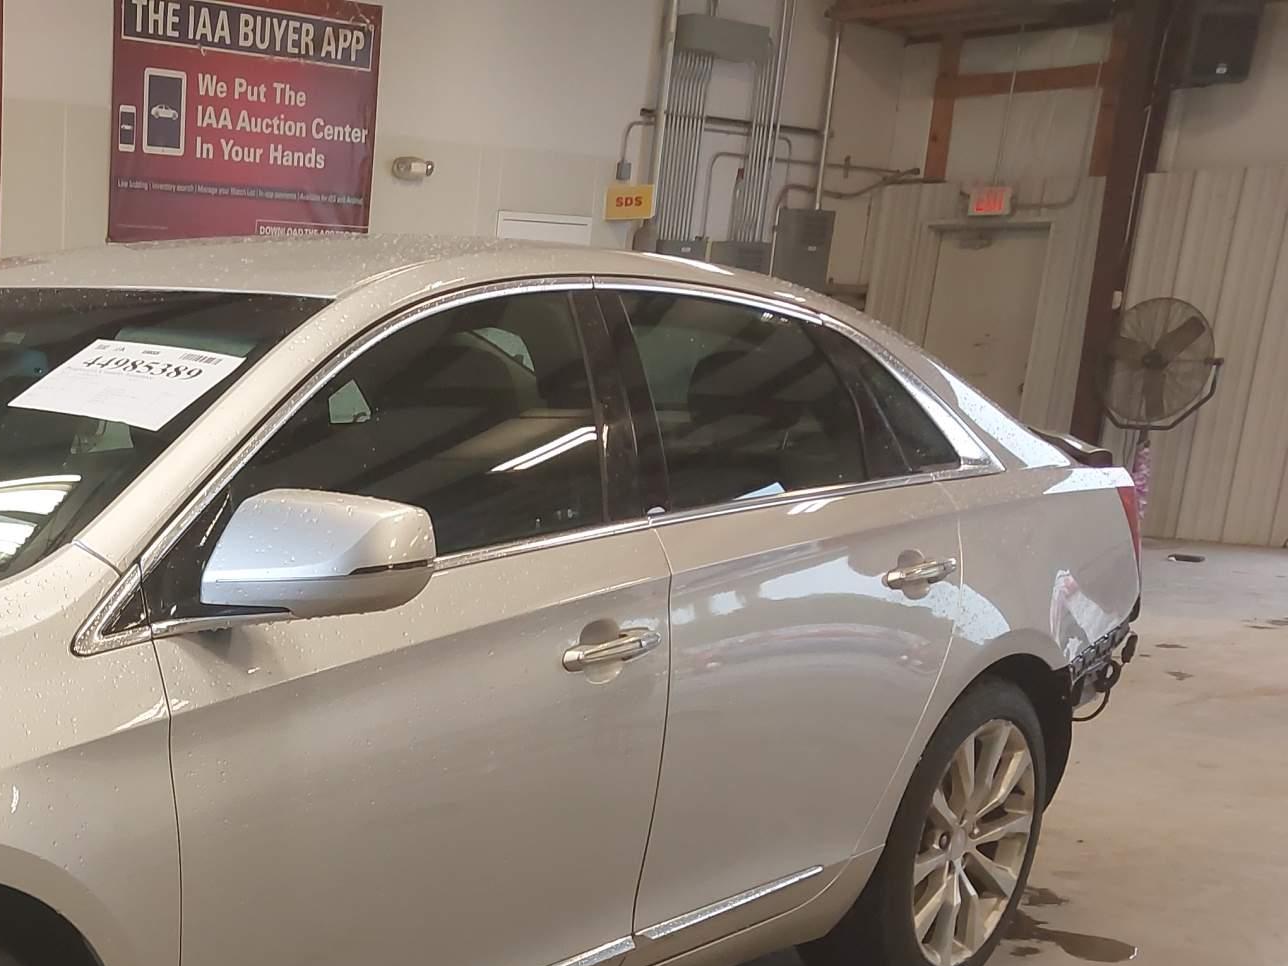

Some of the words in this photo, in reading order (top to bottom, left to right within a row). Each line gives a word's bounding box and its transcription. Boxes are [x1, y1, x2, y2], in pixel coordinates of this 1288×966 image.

[132, 0, 180, 38] THE
[187, 6, 231, 45] IAA
[238, 13, 314, 56] BUYER
[320, 27, 366, 62] APP
[198, 73, 228, 98] We
[234, 78, 267, 103] Put
[273, 82, 307, 107] The
[197, 105, 233, 130] IAA
[236, 109, 307, 138] Auction
[312, 117, 369, 144] Center
[195, 136, 214, 159] In
[220, 138, 264, 164] Your
[269, 143, 326, 169] Hands
[615, 196, 643, 208] SDS
[83, 356, 203, 381] 44985389
